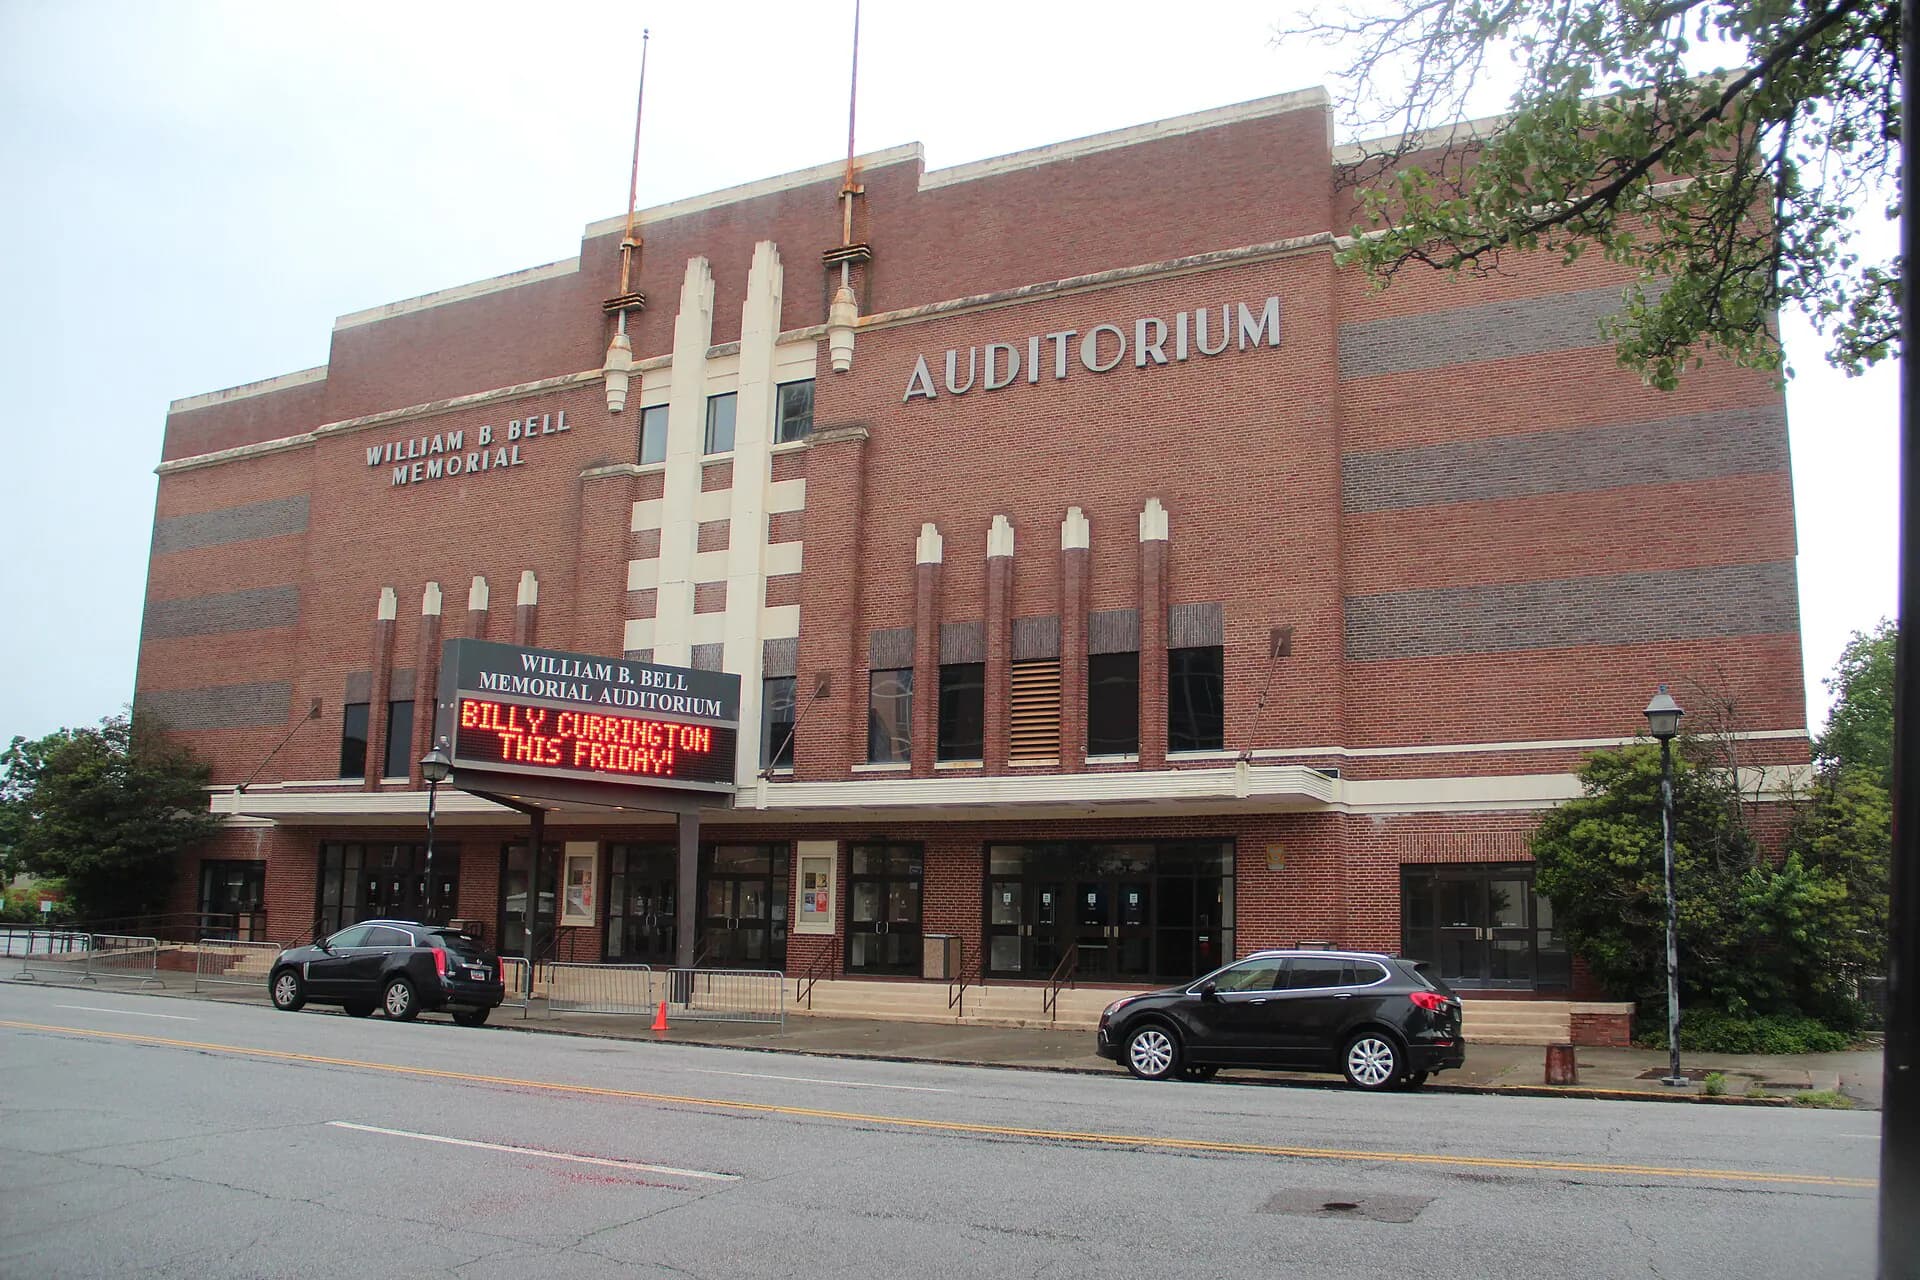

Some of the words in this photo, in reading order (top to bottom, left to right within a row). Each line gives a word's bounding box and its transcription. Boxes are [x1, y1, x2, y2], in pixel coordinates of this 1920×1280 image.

[902, 296, 1281, 402] AUDITORIUM
[366, 430, 464, 466] WILLIAM
[508, 411, 570, 441] BELL
[391, 445, 524, 486] MEMORIAL
[478, 671, 593, 702] MEMORIAL
[599, 687, 722, 717] AUDITORIUM
[520, 653, 612, 682] WILLIAM
[618, 668, 635, 684] B.
[640, 669, 688, 691] BELL
[461, 700, 546, 735] BILLY
[557, 712, 711, 753] CURRINGTON
[498, 732, 562, 764] THIS
[573, 741, 673, 776] FRIDAY!
